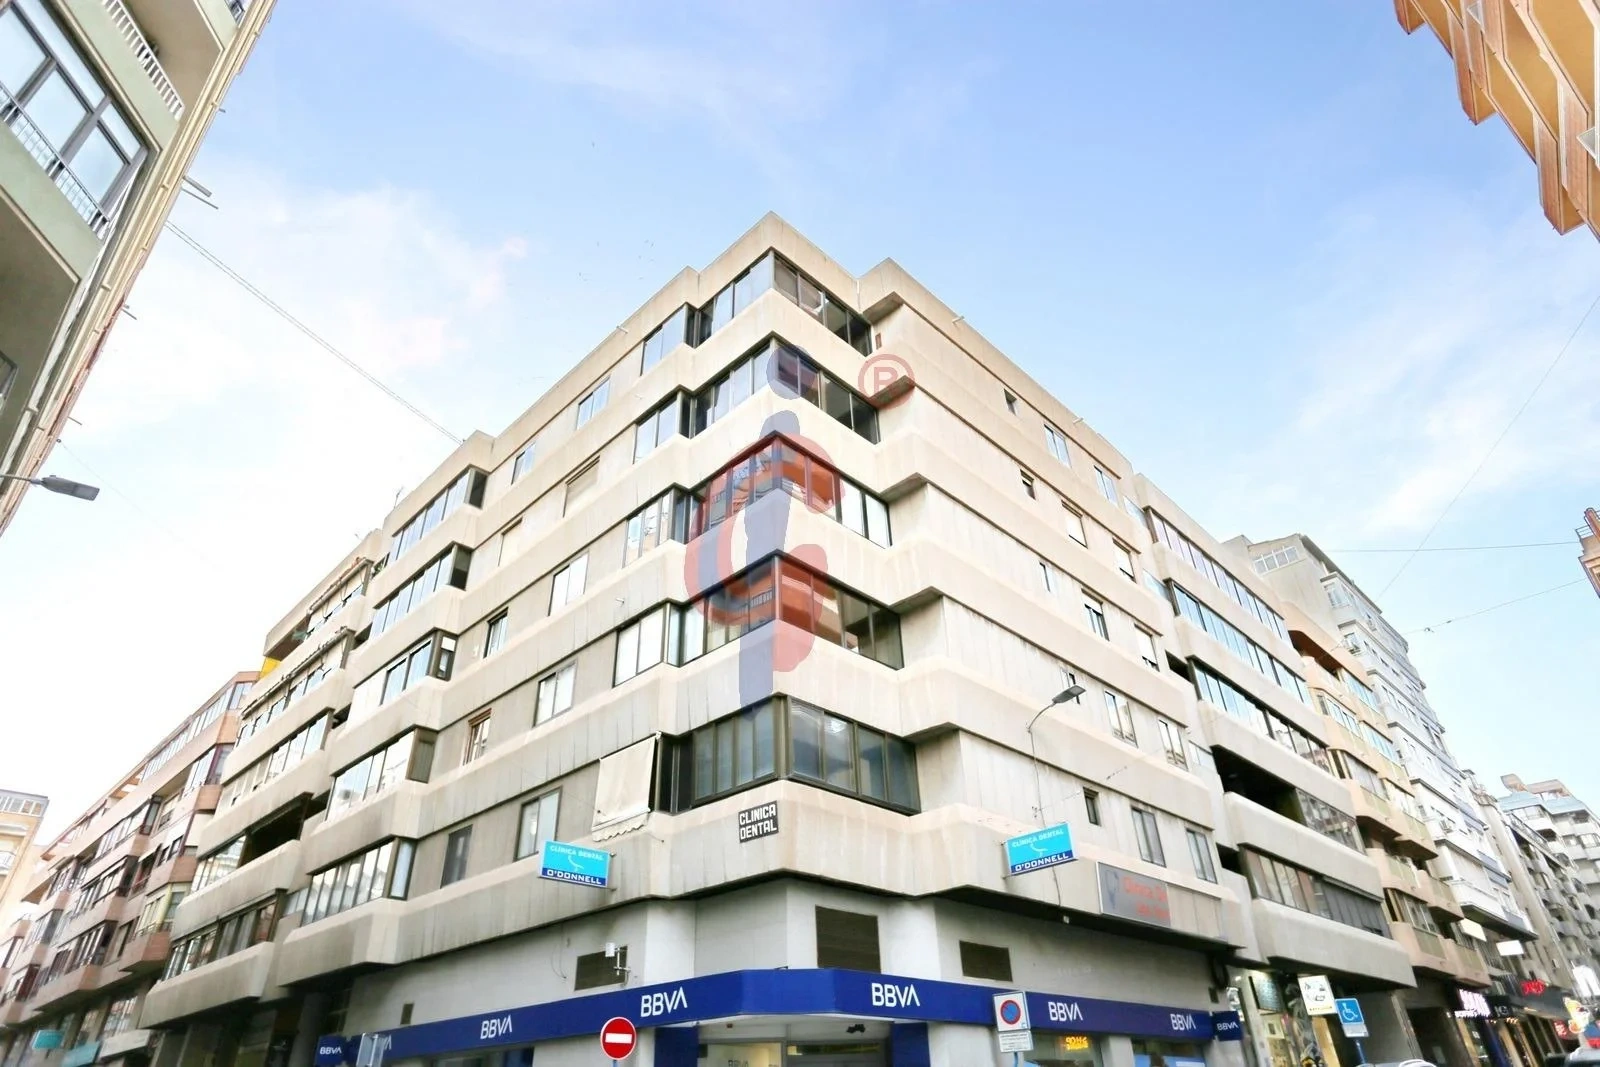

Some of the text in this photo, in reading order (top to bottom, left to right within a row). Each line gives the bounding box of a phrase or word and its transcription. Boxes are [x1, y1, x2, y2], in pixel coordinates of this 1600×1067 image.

[740, 803, 776, 826] CLINICA
[741, 819, 777, 840] DENTAL
[1039, 828, 1064, 841] DENTAL
[1015, 852, 1069, 872] O'DONNELL
[546, 869, 602, 885] O'DONNELL
[640, 986, 688, 1018] BBVA
[872, 982, 921, 1008] BBVA
[1047, 1001, 1084, 1022] BBVA
[480, 1014, 513, 1040] BBVA
[1169, 1013, 1197, 1031] BBVA
[1216, 1021, 1239, 1031] BBVA
[319, 1046, 342, 1055] BBVA
